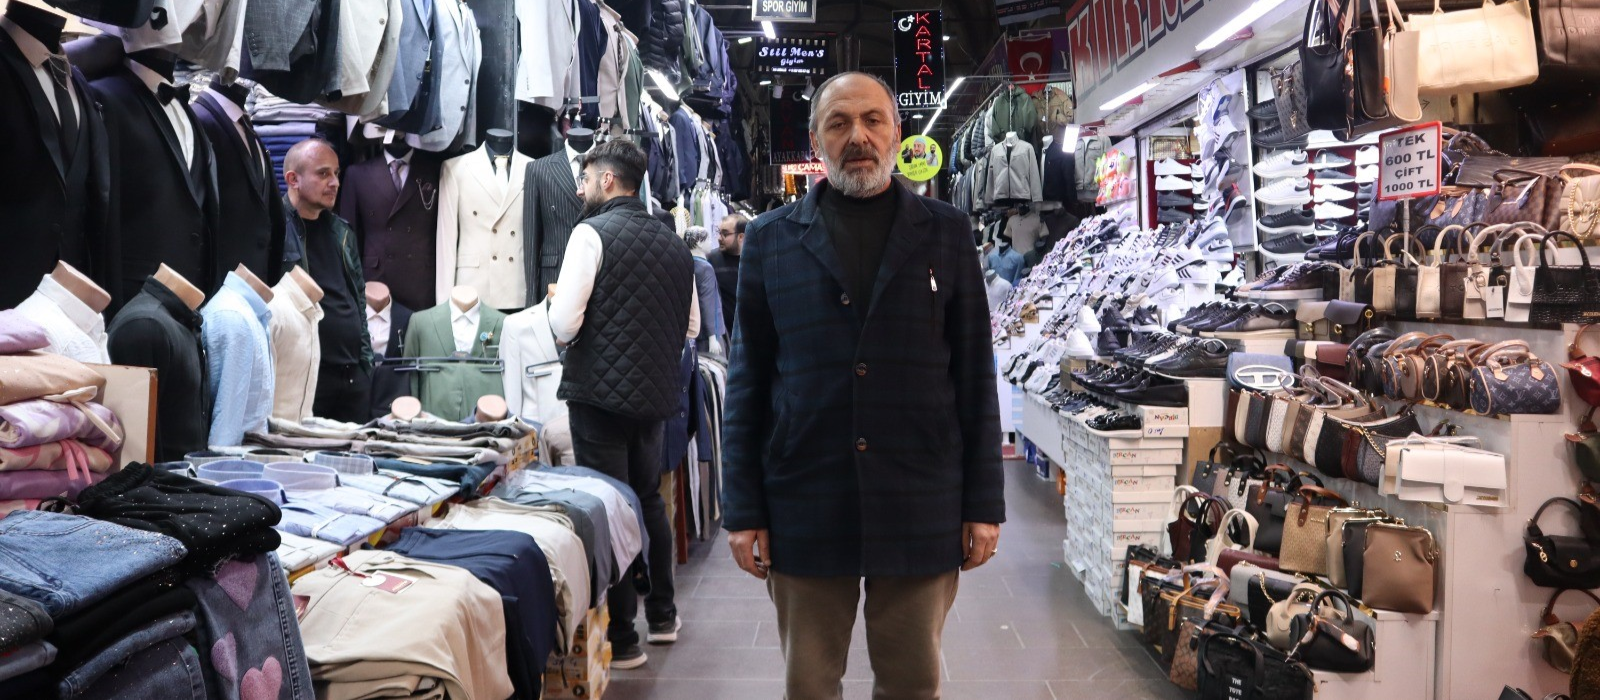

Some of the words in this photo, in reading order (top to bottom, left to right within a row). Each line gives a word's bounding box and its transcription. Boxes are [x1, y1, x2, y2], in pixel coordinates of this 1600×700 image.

[763, 1, 784, 13] SPOR
[759, 47, 787, 57] Stil
[916, 13, 933, 89] KARTAL
[899, 89, 942, 106] GİYİM
[1396, 133, 1425, 147] TEK
[1385, 153, 1412, 166] 600
[1416, 149, 1435, 161] TL
[1395, 166, 1423, 179] ÇİFT
[1385, 181, 1414, 192] 1000
[1418, 179, 1434, 188] TL
